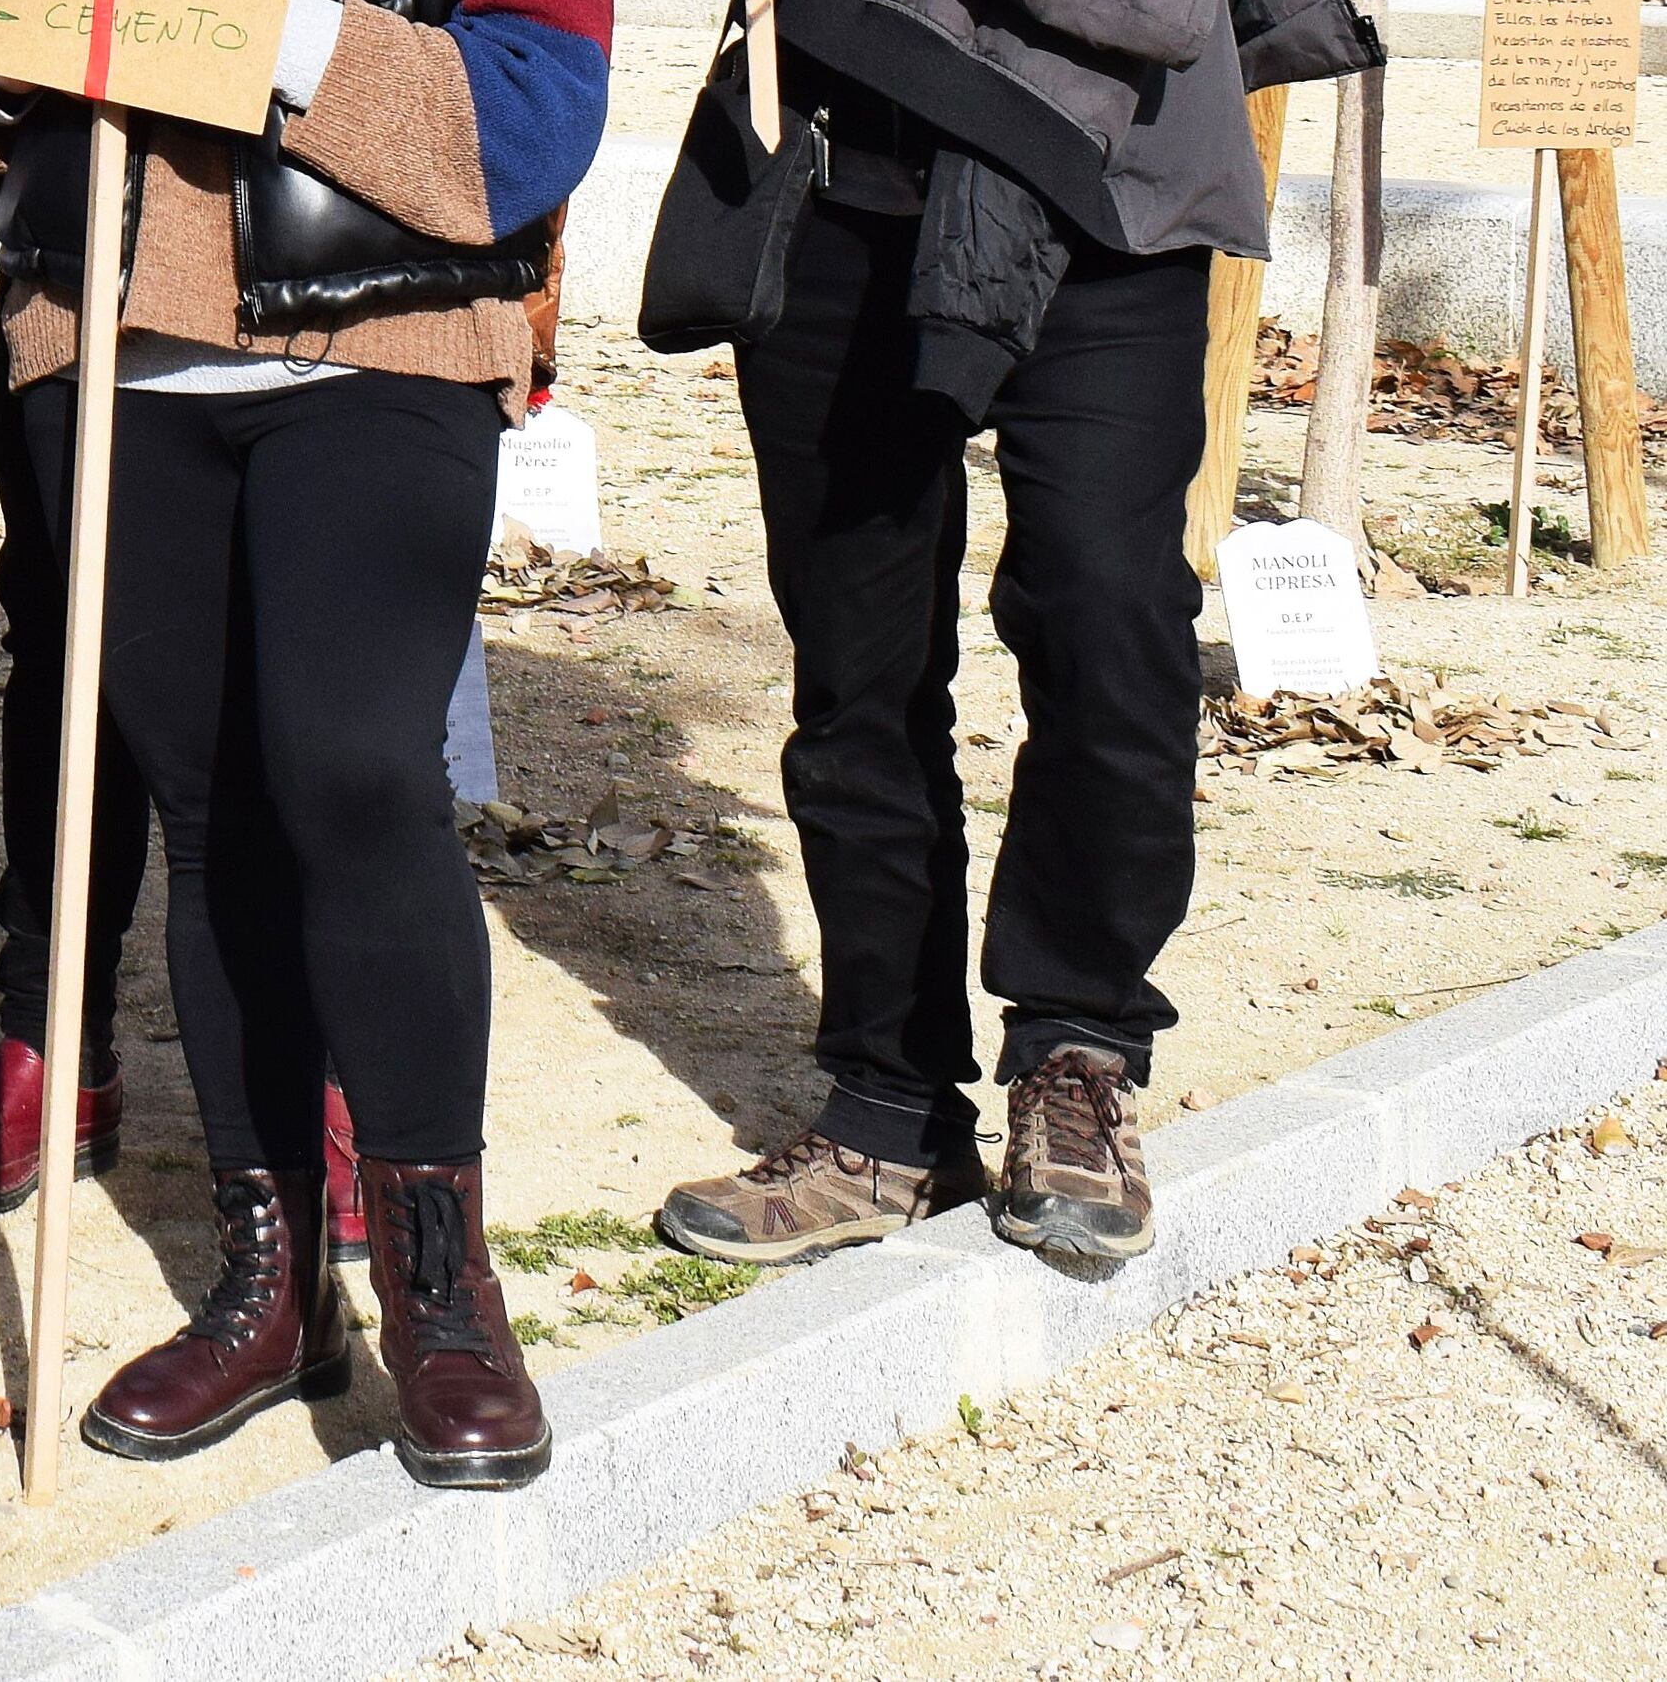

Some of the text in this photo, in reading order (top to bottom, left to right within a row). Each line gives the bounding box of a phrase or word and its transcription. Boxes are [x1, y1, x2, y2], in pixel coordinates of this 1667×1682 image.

[1492, 33, 1554, 47] necesitan
[1560, 36, 1576, 47] de
[1489, 54, 1510, 66] de
[1554, 60, 1563, 74] y
[1581, 54, 1618, 76] juego
[1487, 74, 1507, 88] de
[1512, 72, 1531, 86] los
[1571, 82, 1584, 97] y
[1489, 98, 1565, 113] necesitamos
[1569, 102, 1586, 112] de
[1491, 119, 1533, 137] Cuida
[1535, 120, 1558, 135] de
[1562, 121, 1580, 137] los
[1252, 553, 1327, 571] MANOLI
[1255, 573, 1336, 590] CIPRESA
[1281, 612, 1313, 624] D.E.P
